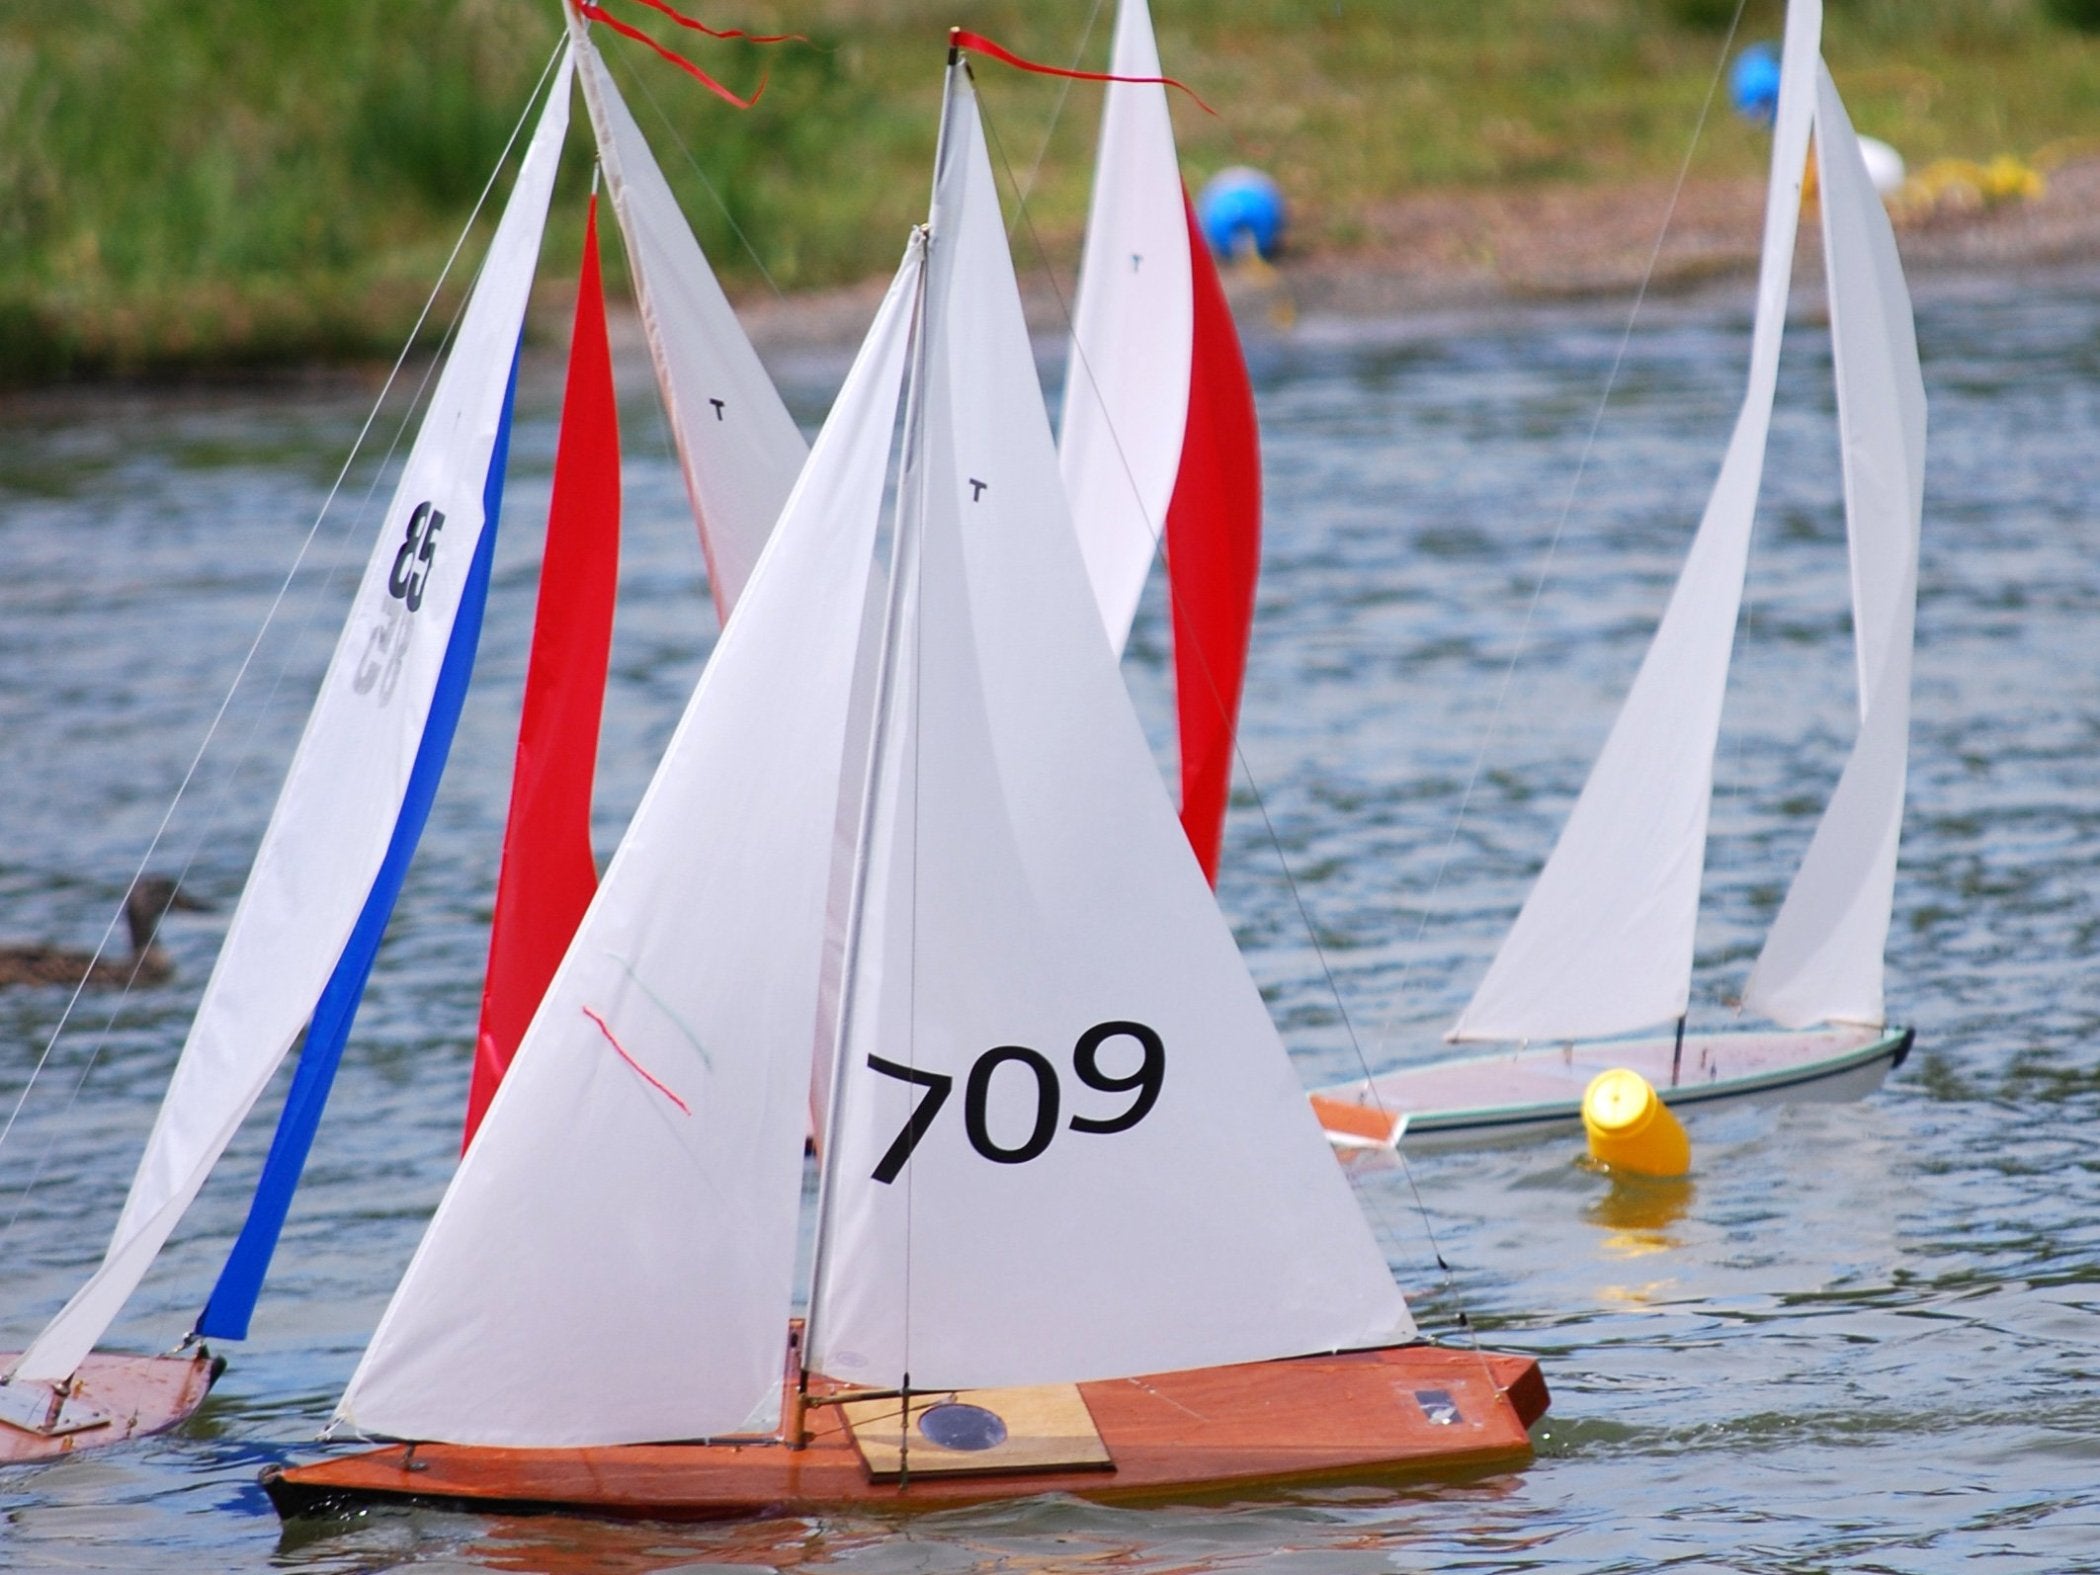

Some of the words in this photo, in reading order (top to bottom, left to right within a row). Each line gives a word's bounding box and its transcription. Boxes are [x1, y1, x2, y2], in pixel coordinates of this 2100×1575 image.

[709, 398, 725, 422] T
[969, 478, 988, 502] T
[388, 501, 446, 613] 85
[867, 1020, 1166, 1185] 709
